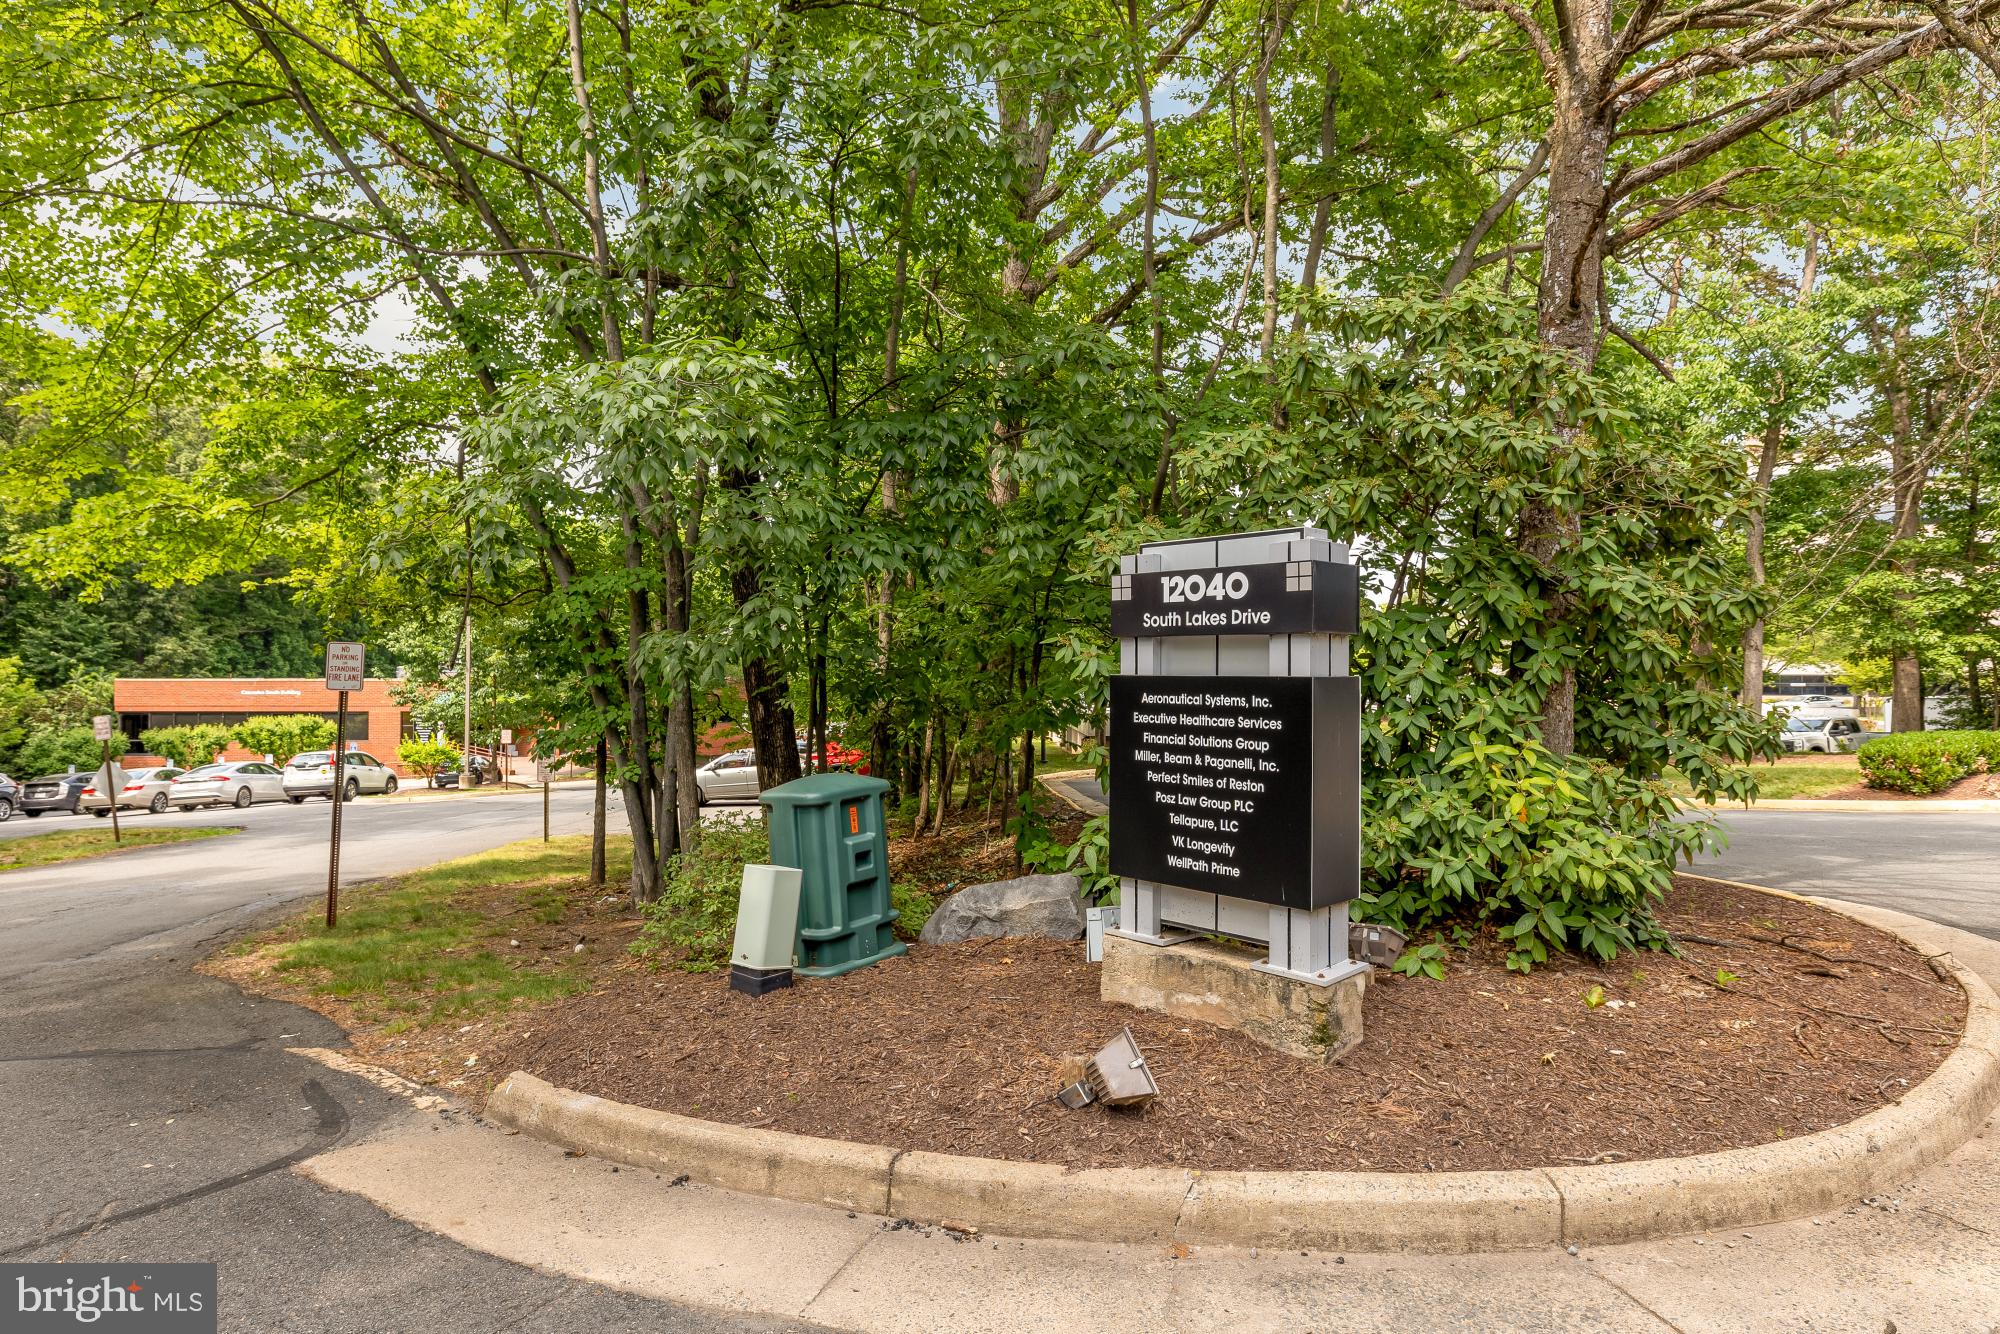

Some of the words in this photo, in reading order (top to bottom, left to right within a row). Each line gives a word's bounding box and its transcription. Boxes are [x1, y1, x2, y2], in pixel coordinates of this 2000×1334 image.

[1161, 572, 1249, 603] 12040
[1143, 611, 1182, 628] South
[1185, 610, 1228, 627] Lakes
[1232, 608, 1271, 625] Drive
[328, 673, 342, 681] FIRE
[343, 674, 360, 682] LANE
[1141, 692, 1203, 706] Aeronautical
[1205, 694, 1249, 709] Systems,
[1252, 695, 1273, 708] Inc.
[1133, 711, 1178, 725] Executive
[1180, 713, 1236, 728] Healthcare
[1238, 716, 1282, 730] Services
[1143, 732, 1187, 746] Financial
[1188, 734, 1233, 749] Solutions
[1236, 737, 1270, 753] Group
[1135, 749, 1162, 764] Miller,
[1164, 751, 1193, 765] Beam
[1194, 753, 1203, 766] &
[1204, 755, 1256, 772] Paganelli,
[1259, 758, 1280, 773] Inc.
[1147, 770, 1181, 785] Perfect
[1182, 773, 1214, 788] Smiles
[1216, 777, 1227, 789] of
[1229, 777, 1265, 793] Reston
[1155, 791, 1176, 804] Posz
[1178, 793, 1198, 807] Law
[1199, 796, 1232, 812] Group
[1234, 799, 1255, 813] PLC
[1169, 812, 1217, 832] Tellapure,
[1220, 818, 1239, 833] LLC
[1172, 834, 1185, 848] VK
[1186, 837, 1236, 857] Longevity
[1167, 854, 1209, 873] WellPath
[1211, 861, 1241, 878] Prime
